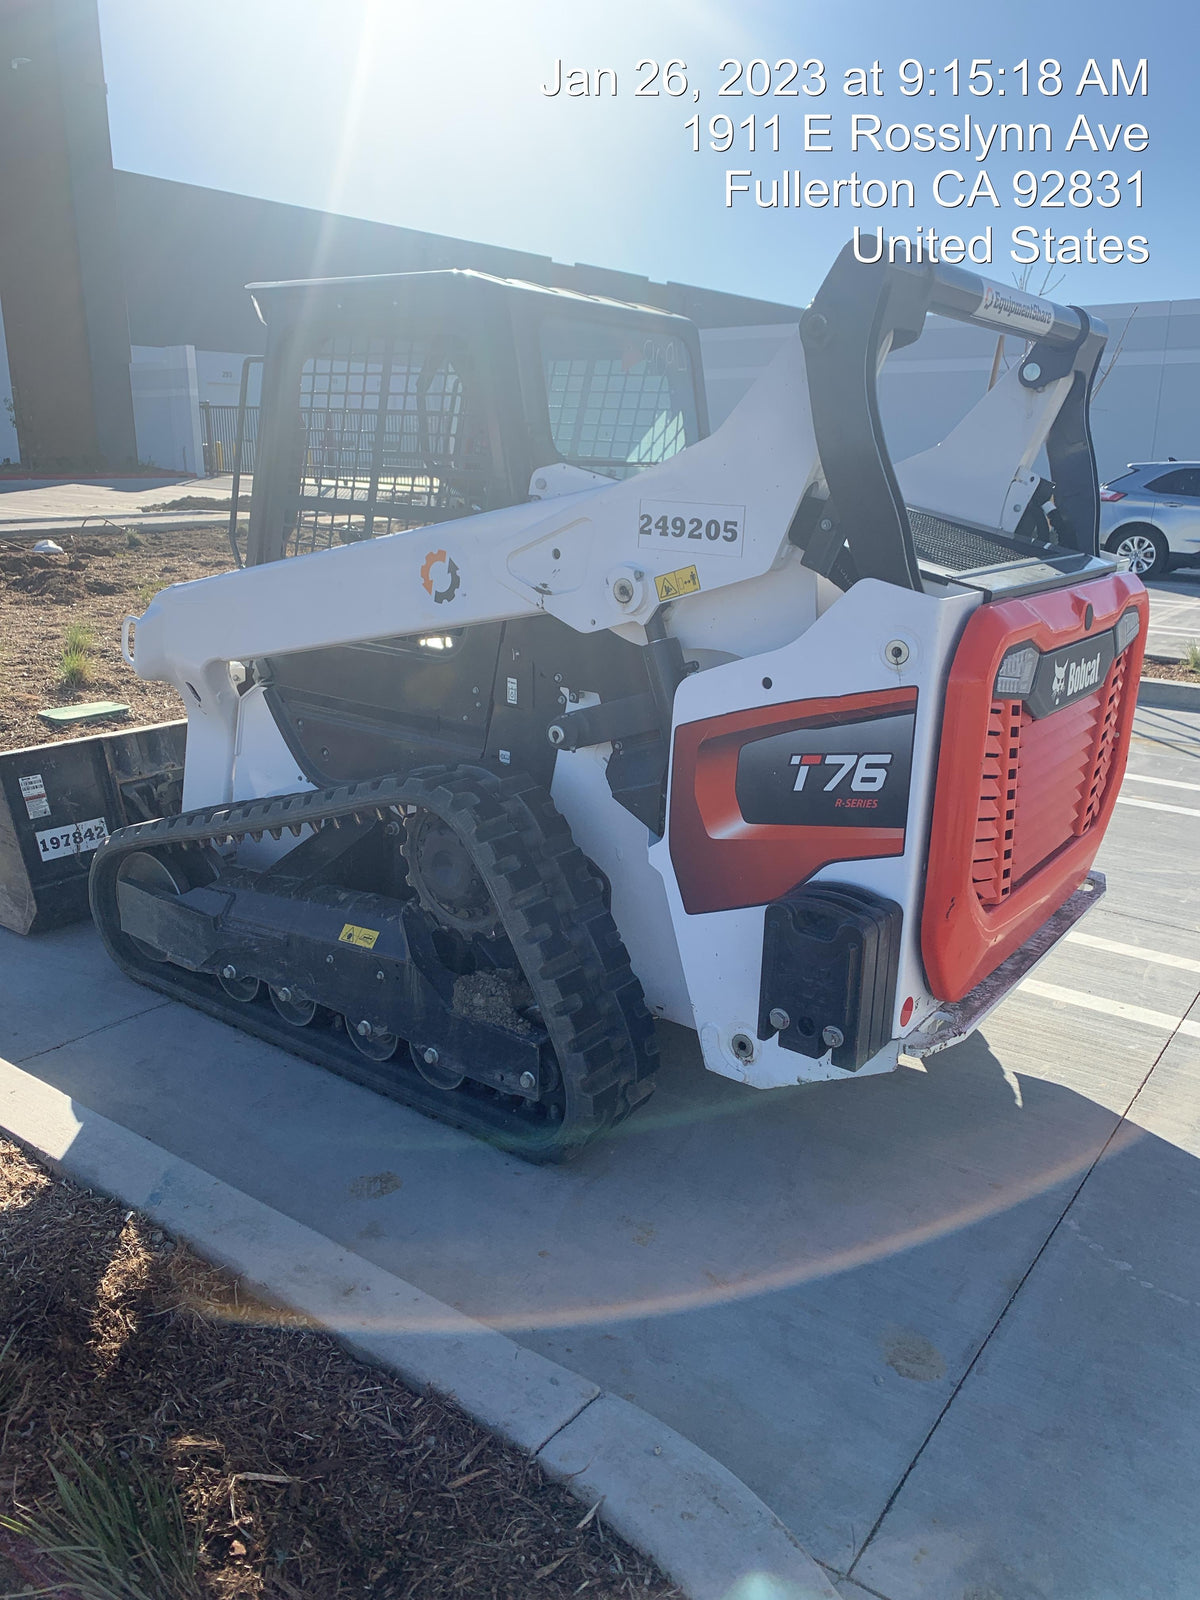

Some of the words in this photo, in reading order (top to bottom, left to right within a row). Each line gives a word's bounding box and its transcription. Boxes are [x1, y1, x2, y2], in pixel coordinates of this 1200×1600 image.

[993, 291, 1052, 324] EquipmentShare
[639, 513, 738, 543] 249205
[1067, 652, 1100, 696] Bobcat
[790, 754, 892, 792] T76
[834, 798, 879, 809] R-SERIES
[40, 825, 106, 852] 197842
